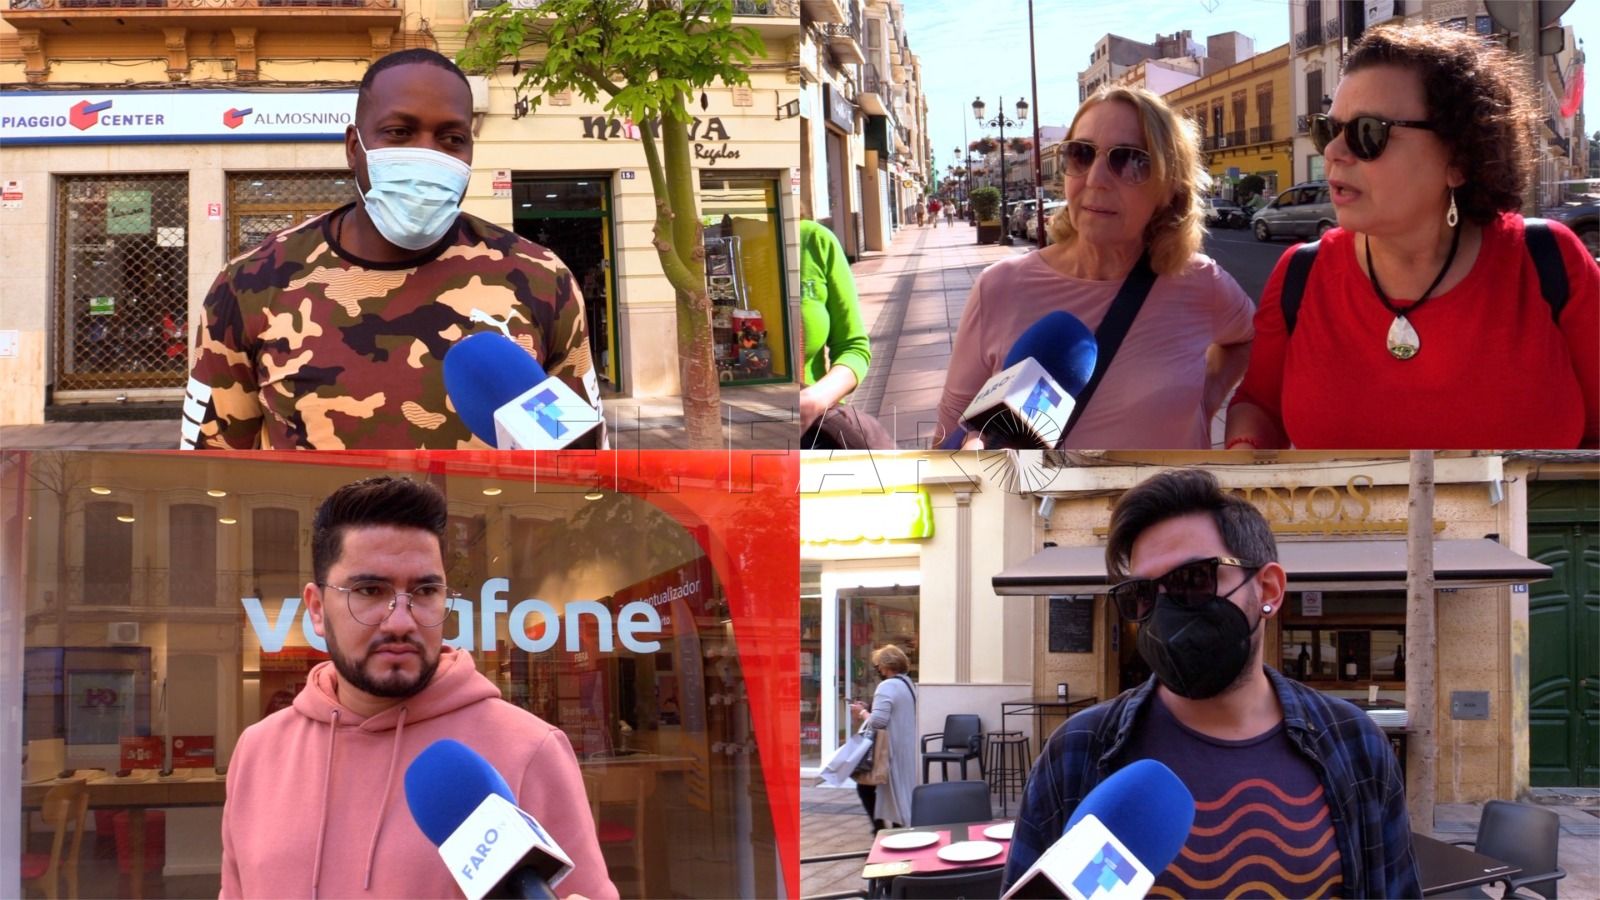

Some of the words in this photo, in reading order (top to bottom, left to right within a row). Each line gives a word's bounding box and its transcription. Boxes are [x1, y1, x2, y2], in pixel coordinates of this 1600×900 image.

[2, 116, 67, 128] PIAGGIO
[101, 114, 165, 126] CENTER
[254, 112, 352, 125] ALMOSNINO
[694, 143, 740, 165] Regalos
[240, 577, 663, 654] vafone
[461, 828, 499, 880] FARO
